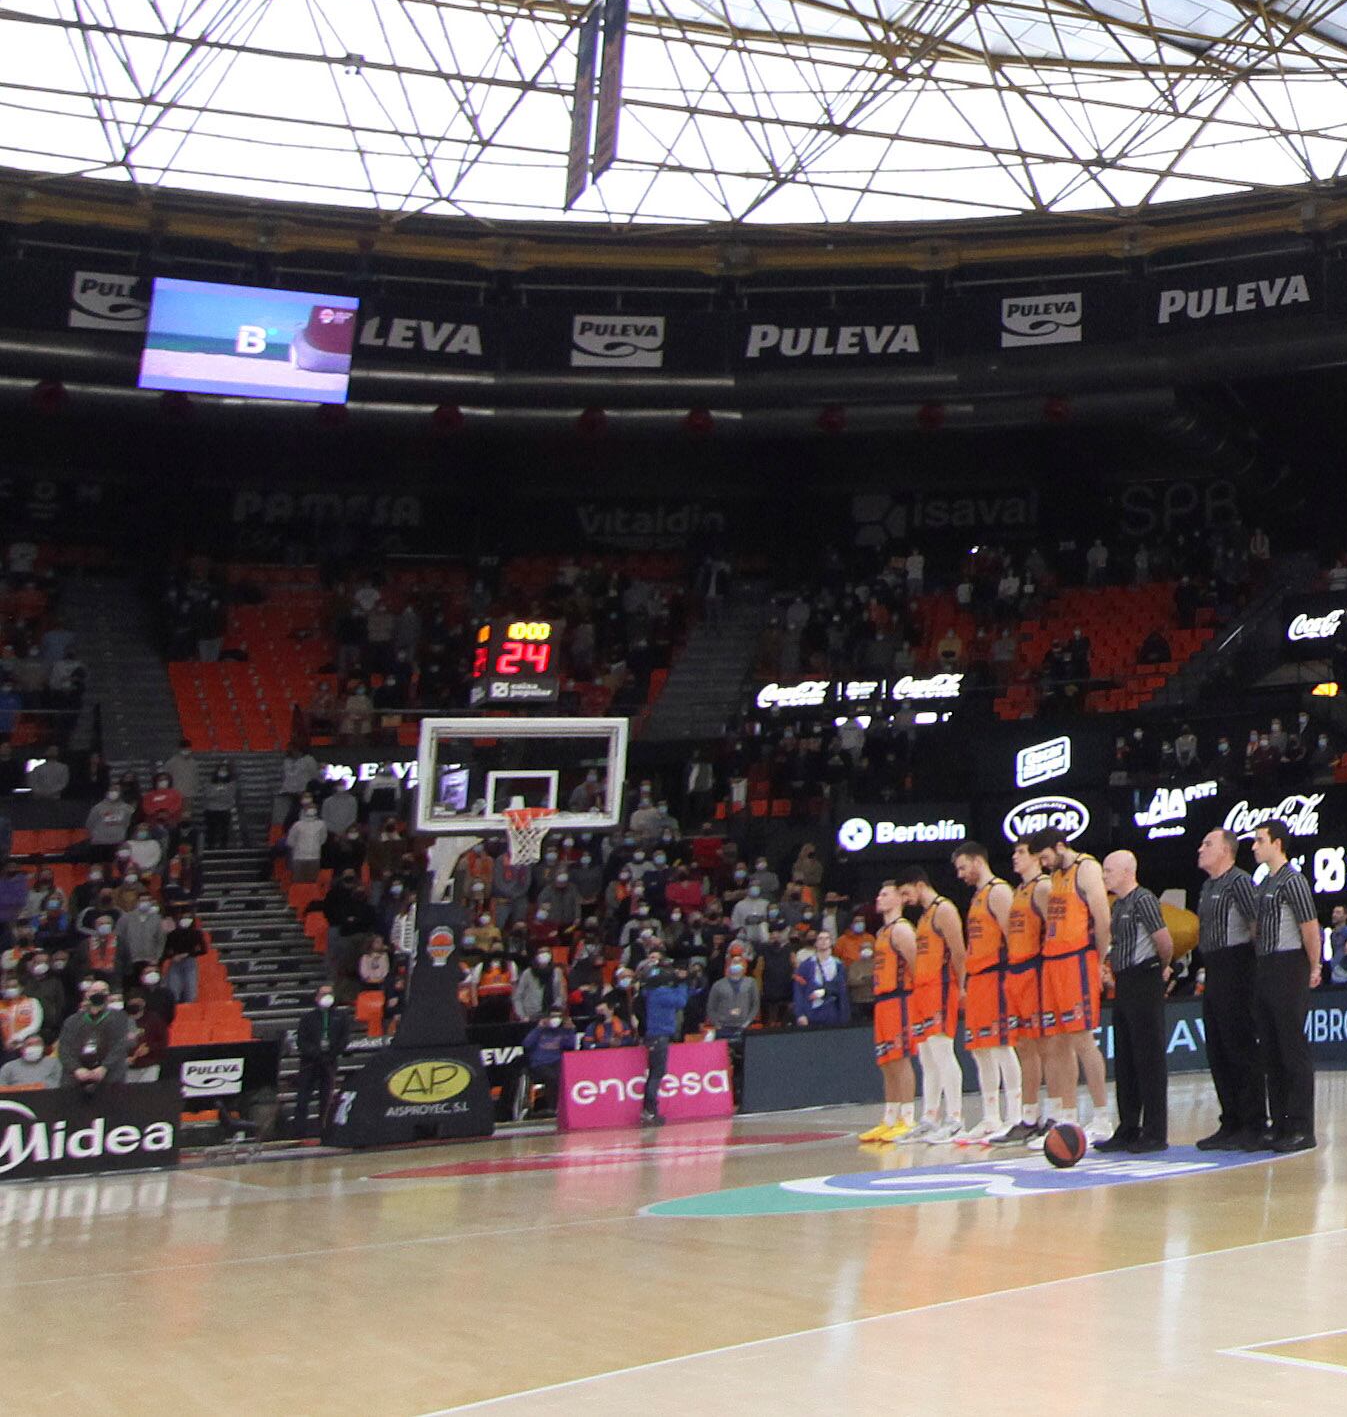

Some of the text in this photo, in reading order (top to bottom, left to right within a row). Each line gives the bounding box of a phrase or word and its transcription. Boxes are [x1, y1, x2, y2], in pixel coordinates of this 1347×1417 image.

[1006, 300, 1077, 319] PULEVA
[1158, 275, 1310, 324] PULEVA
[235, 325, 268, 355] B
[360, 317, 483, 356] LEVA
[579, 321, 659, 339] PULEVA
[746, 324, 920, 358] PULEVA
[496, 642, 551, 674] 24
[875, 820, 965, 844] Bertolín
[187, 1063, 241, 1076] PULEVA
[401, 1064, 458, 1096] AP
[0, 1116, 175, 1164] Midea
